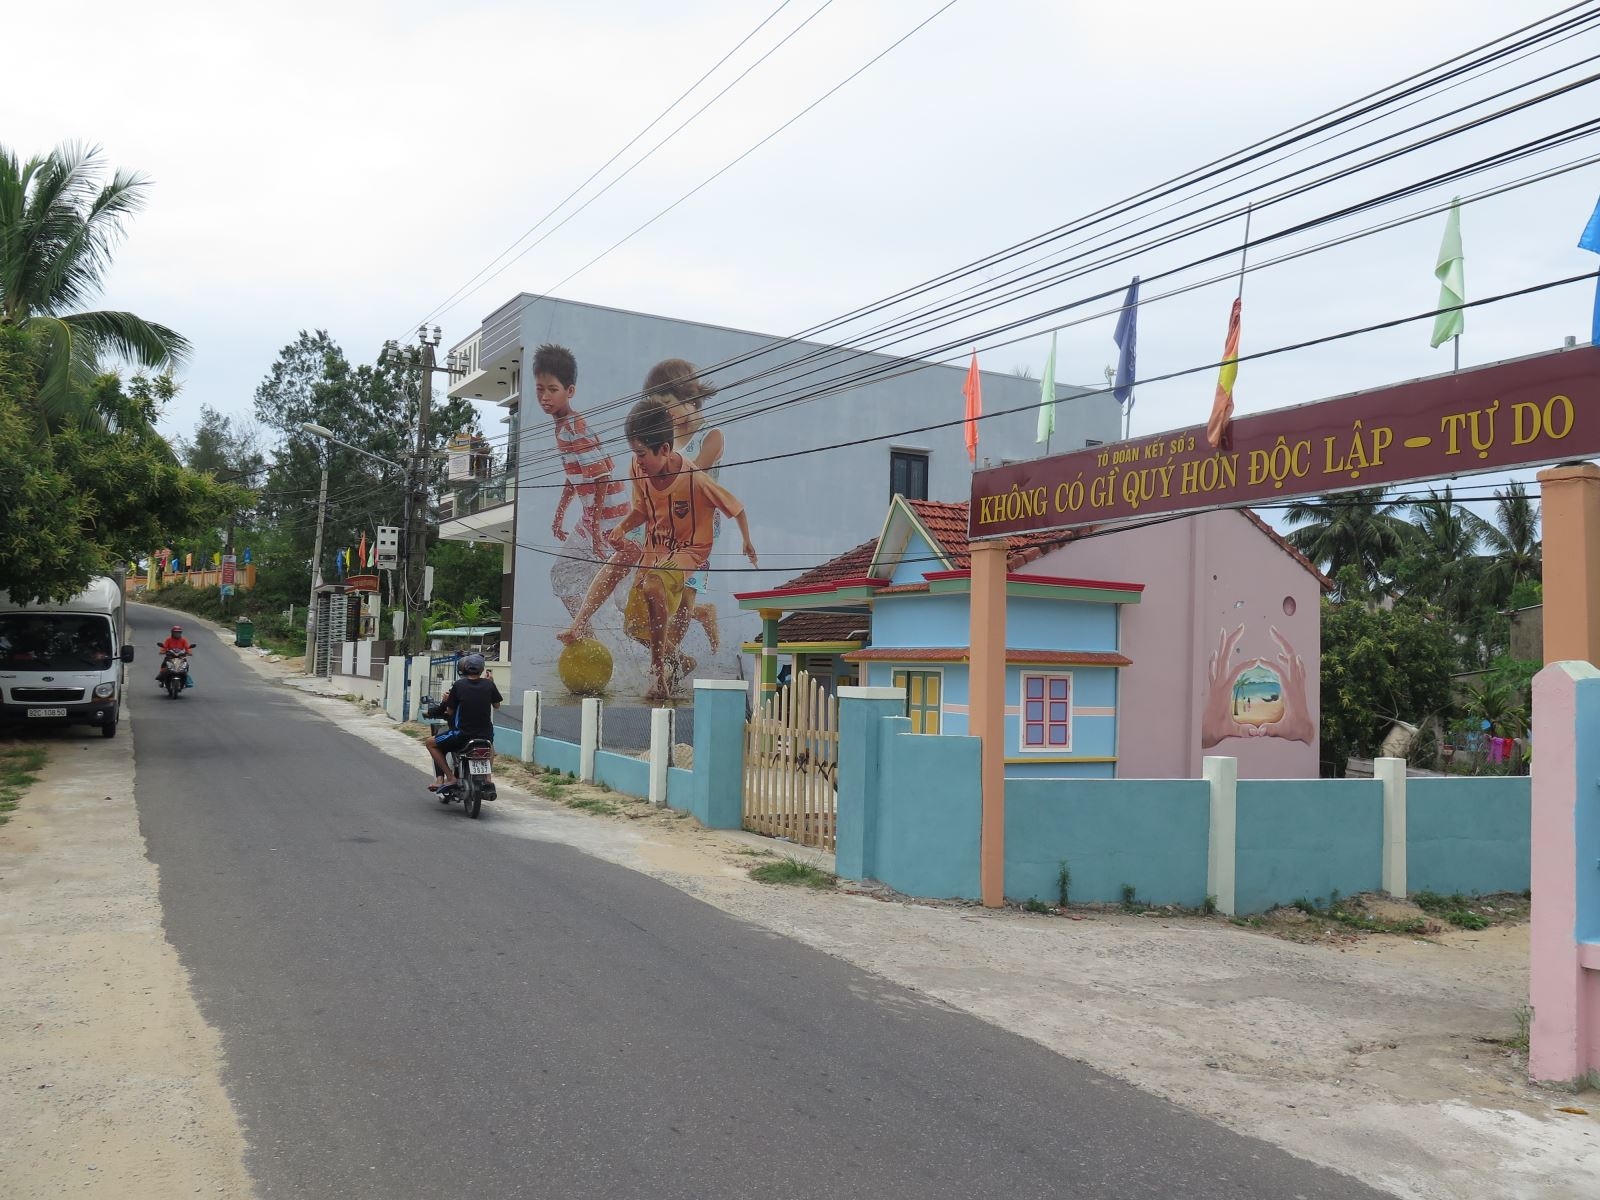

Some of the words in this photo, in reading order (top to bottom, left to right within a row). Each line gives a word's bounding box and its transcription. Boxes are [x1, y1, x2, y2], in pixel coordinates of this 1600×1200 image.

[979, 483, 1048, 525] KHÔNG
[1054, 472, 1085, 514] CÓ
[1090, 467, 1120, 507] GÌ
[1122, 456, 1175, 510] QUÝ
[1180, 451, 1240, 495] HƠN
[1248, 436, 1311, 489] ĐỘC
[1323, 420, 1393, 479] LẬP
[1441, 399, 1500, 459] TỰ
[1511, 394, 1575, 446] DO
[1097, 446, 1109, 467] TỔ
[1112, 444, 1140, 465] ĐOÀN
[1144, 437, 1165, 459] KẾT
[1170, 431, 1187, 454] SỐ
[1188, 436, 1195, 451] 3
